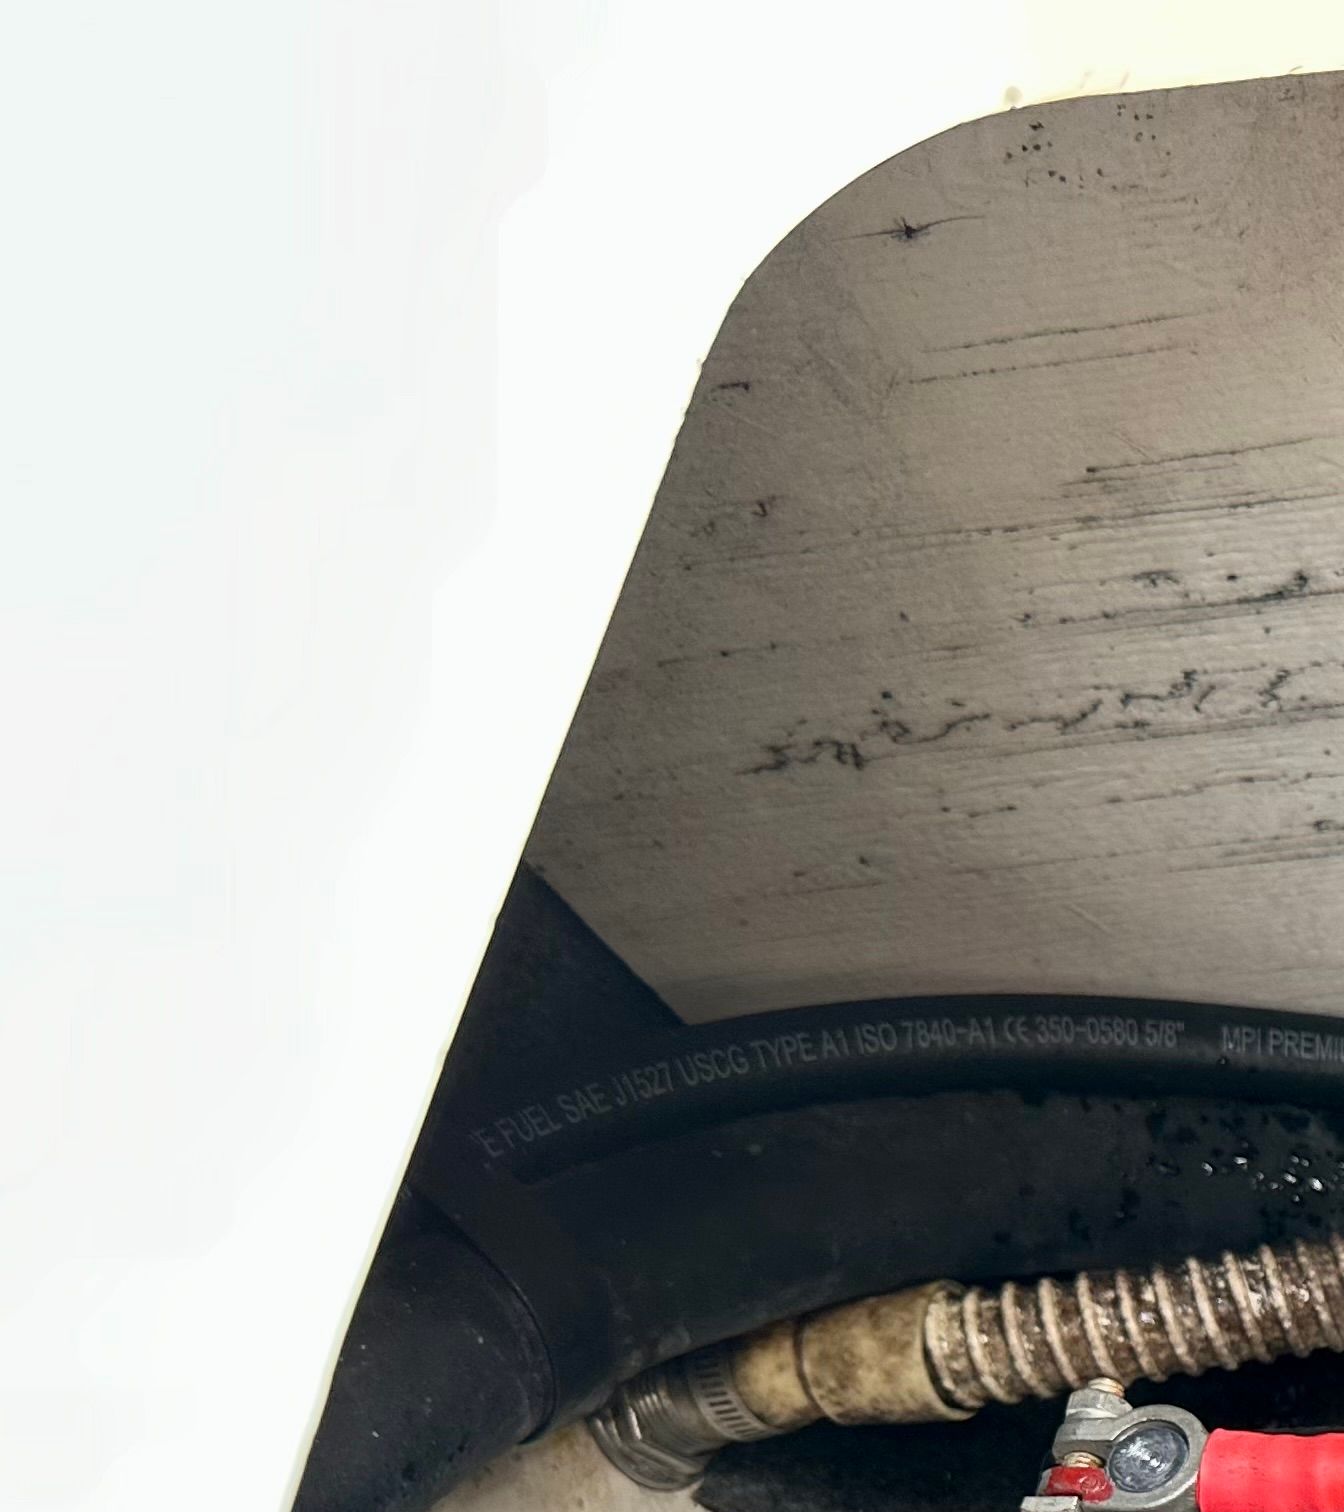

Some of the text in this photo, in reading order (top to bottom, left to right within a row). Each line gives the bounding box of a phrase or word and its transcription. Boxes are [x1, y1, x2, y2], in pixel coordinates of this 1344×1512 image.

[557, 1083, 610, 1124] SAE
[680, 1044, 749, 1086] USCG
[748, 1033, 818, 1068] TYPE
[821, 1028, 848, 1059] A1
[855, 1023, 898, 1053] ISO
[902, 1015, 996, 1049] 7840-A1
[1036, 1015, 1139, 1047] 350-0580
[1222, 1025, 1262, 1054] MPI
